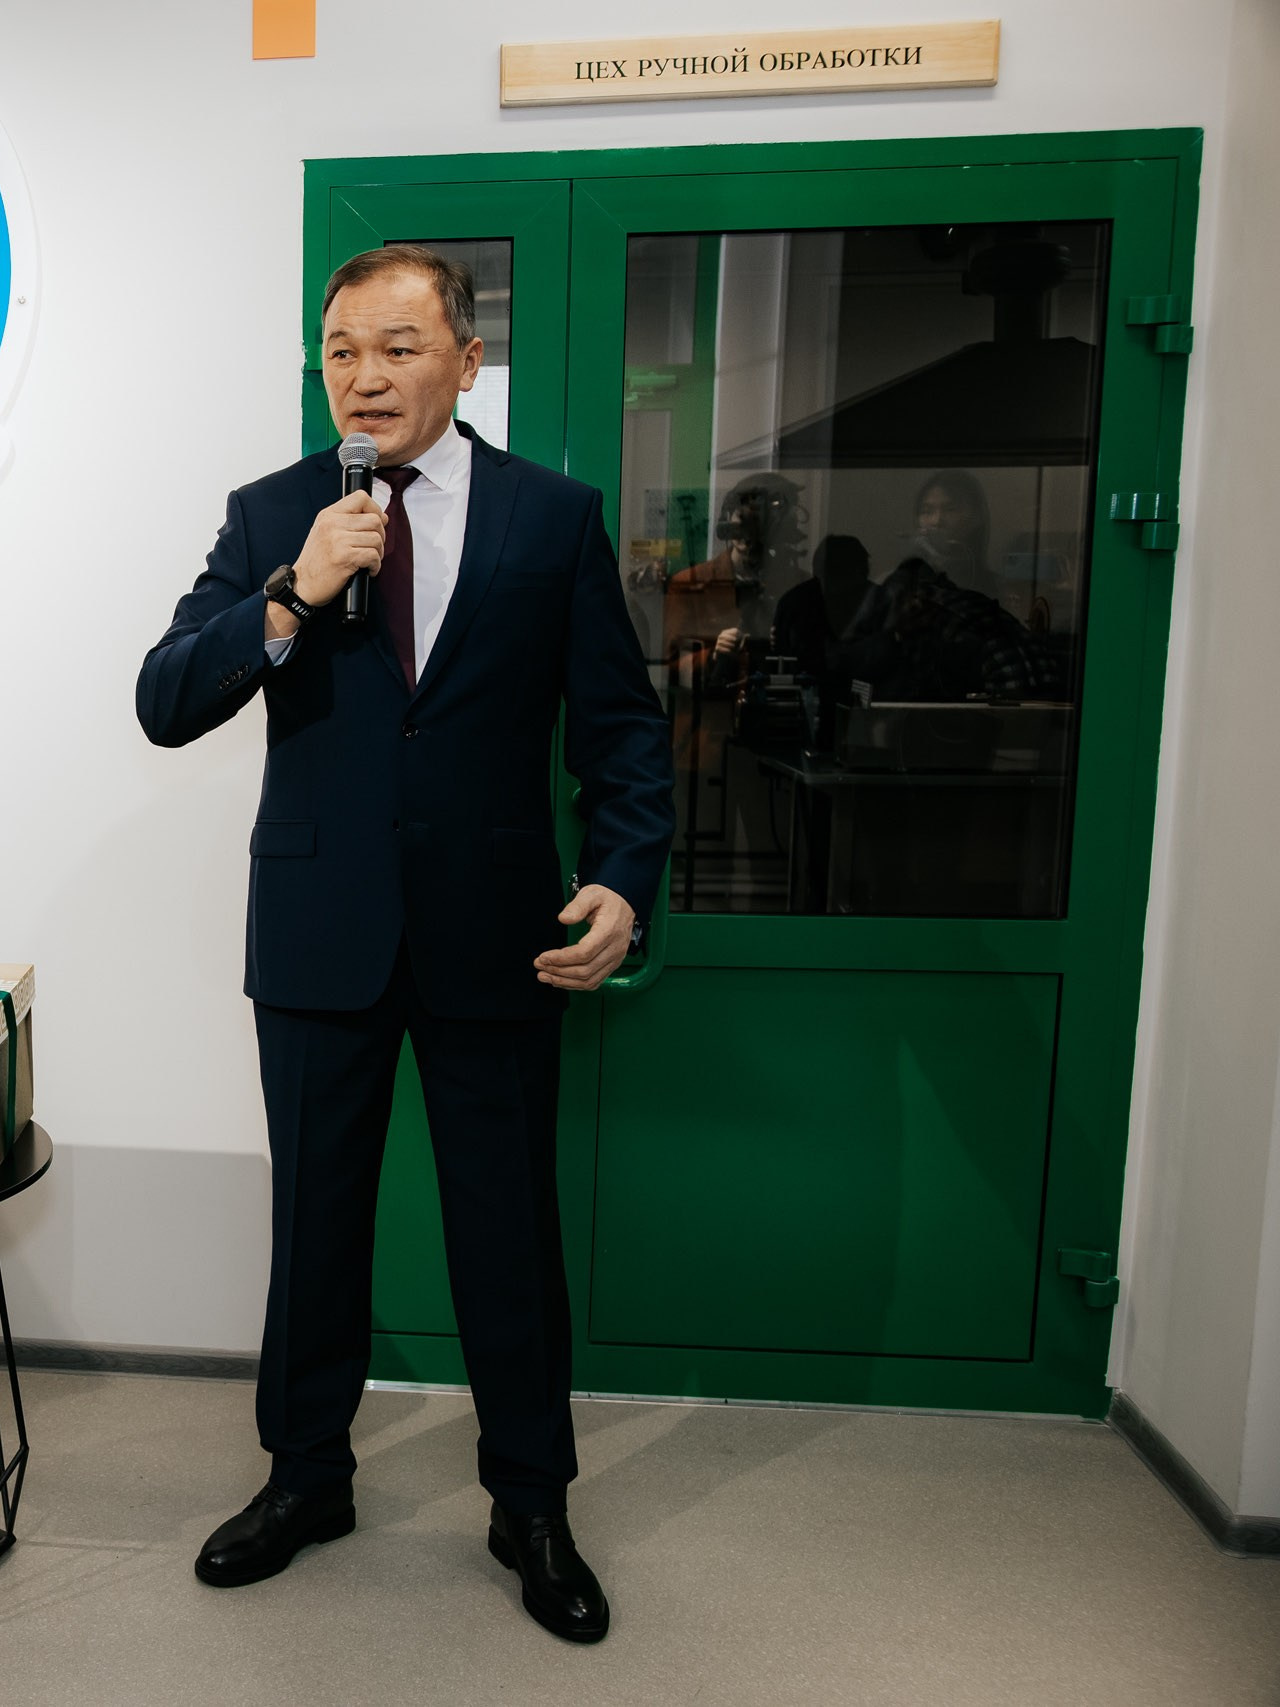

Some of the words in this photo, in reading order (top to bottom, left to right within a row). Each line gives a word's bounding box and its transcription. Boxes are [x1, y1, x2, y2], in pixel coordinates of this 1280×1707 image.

[574, 60, 628, 83] ЦЕХ
[638, 48, 750, 78] РУЧНОЙ
[759, 46, 923, 72] ОБРАБОТКИ
